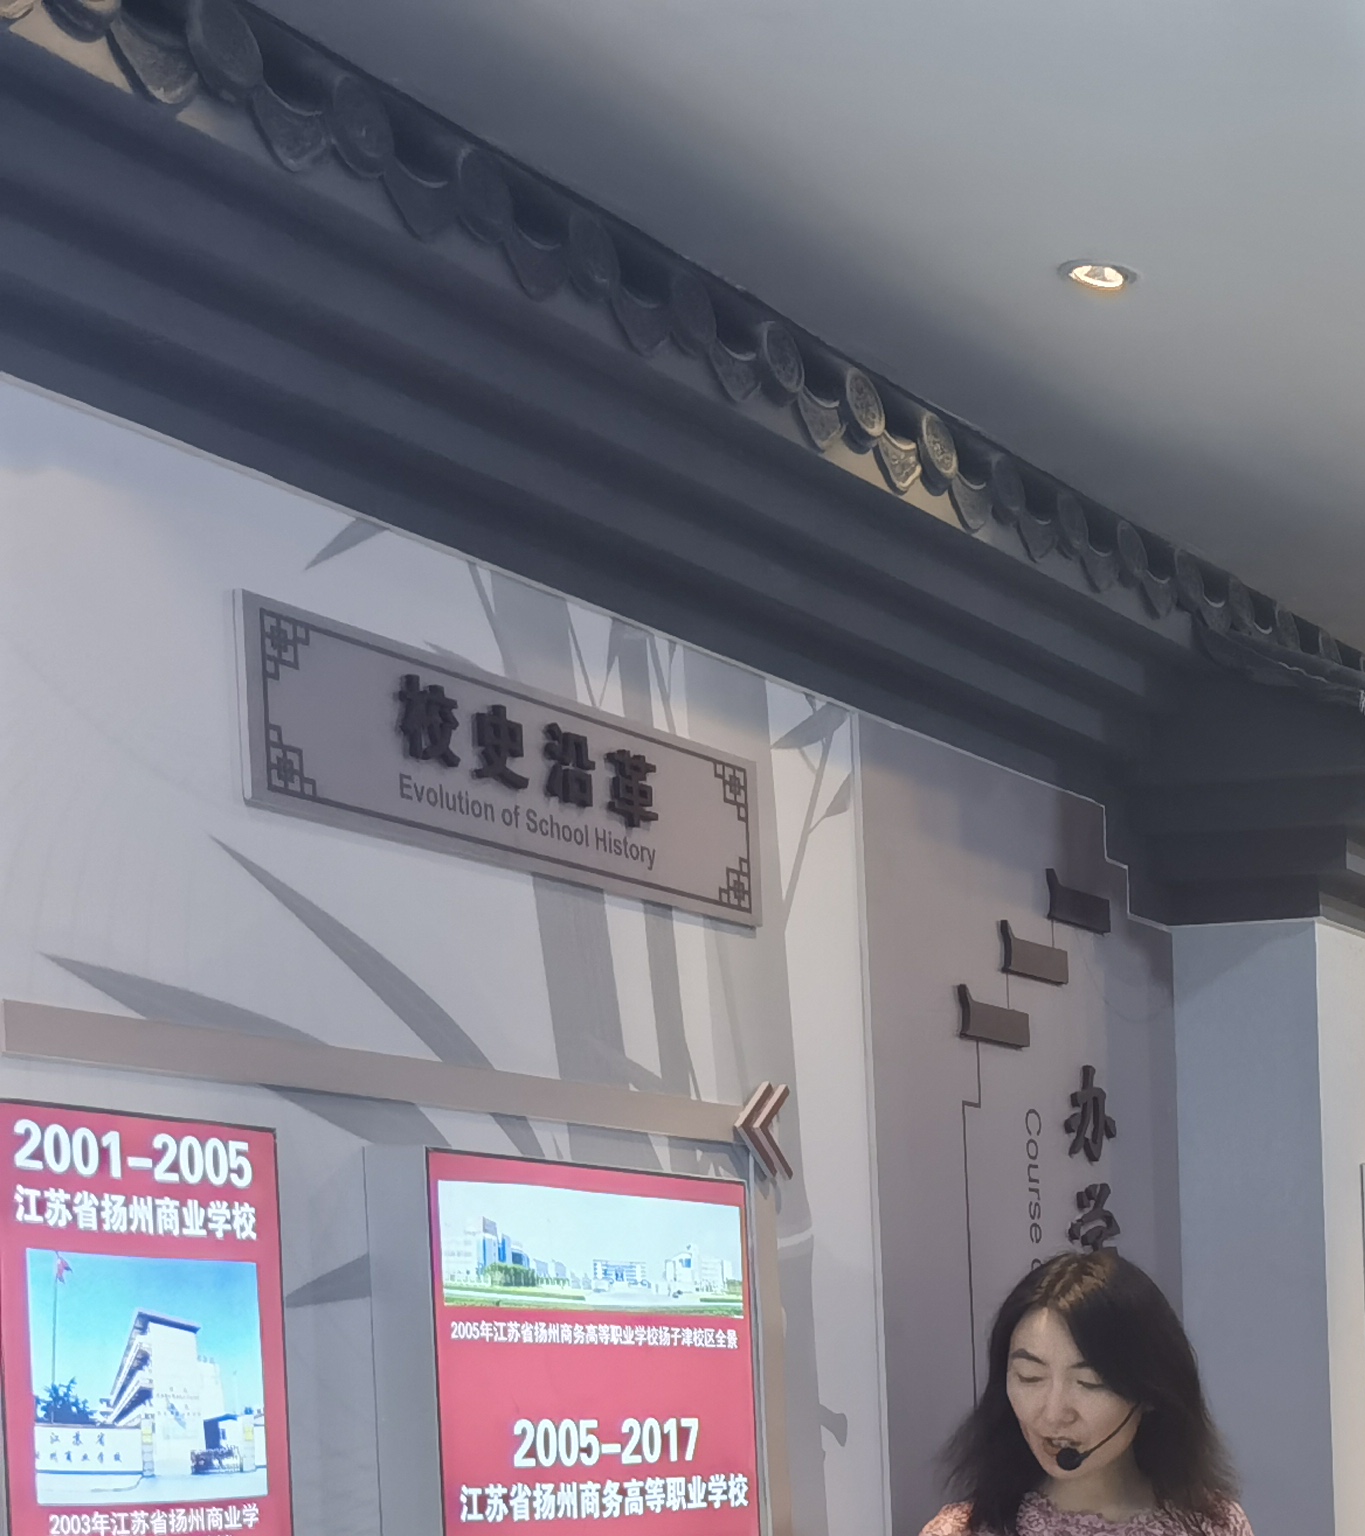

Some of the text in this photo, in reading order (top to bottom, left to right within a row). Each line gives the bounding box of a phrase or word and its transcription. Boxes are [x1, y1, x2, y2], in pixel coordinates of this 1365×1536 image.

[394, 674, 659, 828] 校史沿革
[399, 772, 657, 871] Evolution of School History
[13, 1118, 253, 1189] 2001-2005
[1025, 1107, 1044, 1245] Course
[14, 1185, 258, 1241] 江苏省扬州商业学校
[450, 1320, 739, 1349] 2005年江苏省扬州商务高等职业学校扬子津校区全景
[513, 1417, 700, 1469] 2005-2017
[459, 1473, 750, 1524] 江苏省扬州商务高等职业学校
